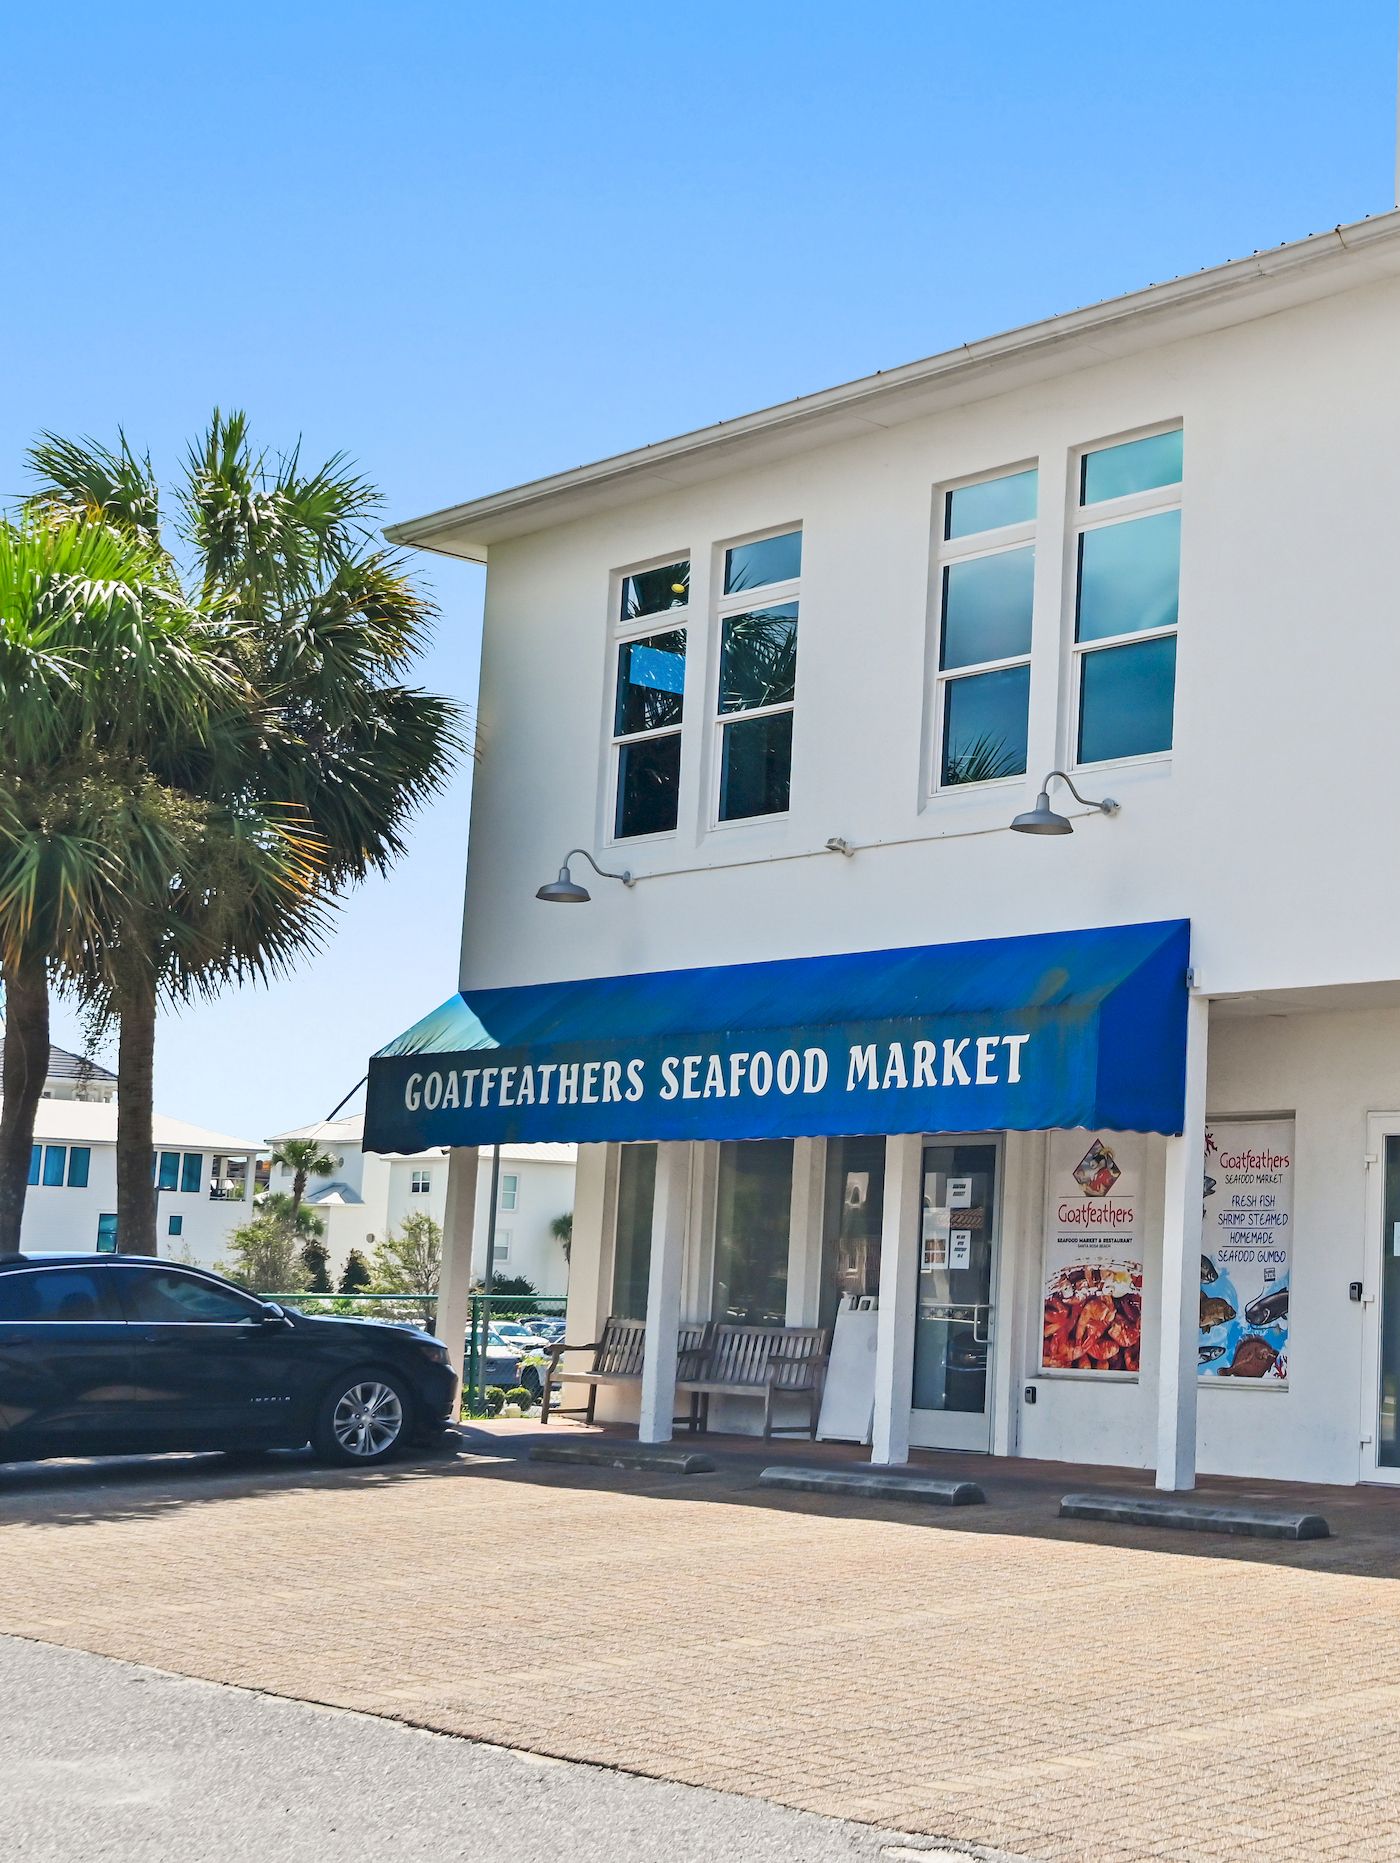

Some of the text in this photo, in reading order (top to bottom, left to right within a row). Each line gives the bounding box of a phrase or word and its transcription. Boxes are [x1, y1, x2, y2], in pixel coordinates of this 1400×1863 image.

[405, 1033, 1031, 1112] GOATFEATHERS SEAFOOD MARKET
[1220, 1148, 1290, 1173] Goatfeathers
[1225, 1173, 1283, 1185] SEAFOOD MARKET
[1231, 1195, 1276, 1207] FRESH FISH
[1058, 1200, 1134, 1228] Goatfeathers
[1217, 1213, 1289, 1226] SHRIMP STEAMED
[1229, 1231, 1275, 1244] HOMEMADE
[1217, 1250, 1287, 1262] SEAFOOD GUMBO
